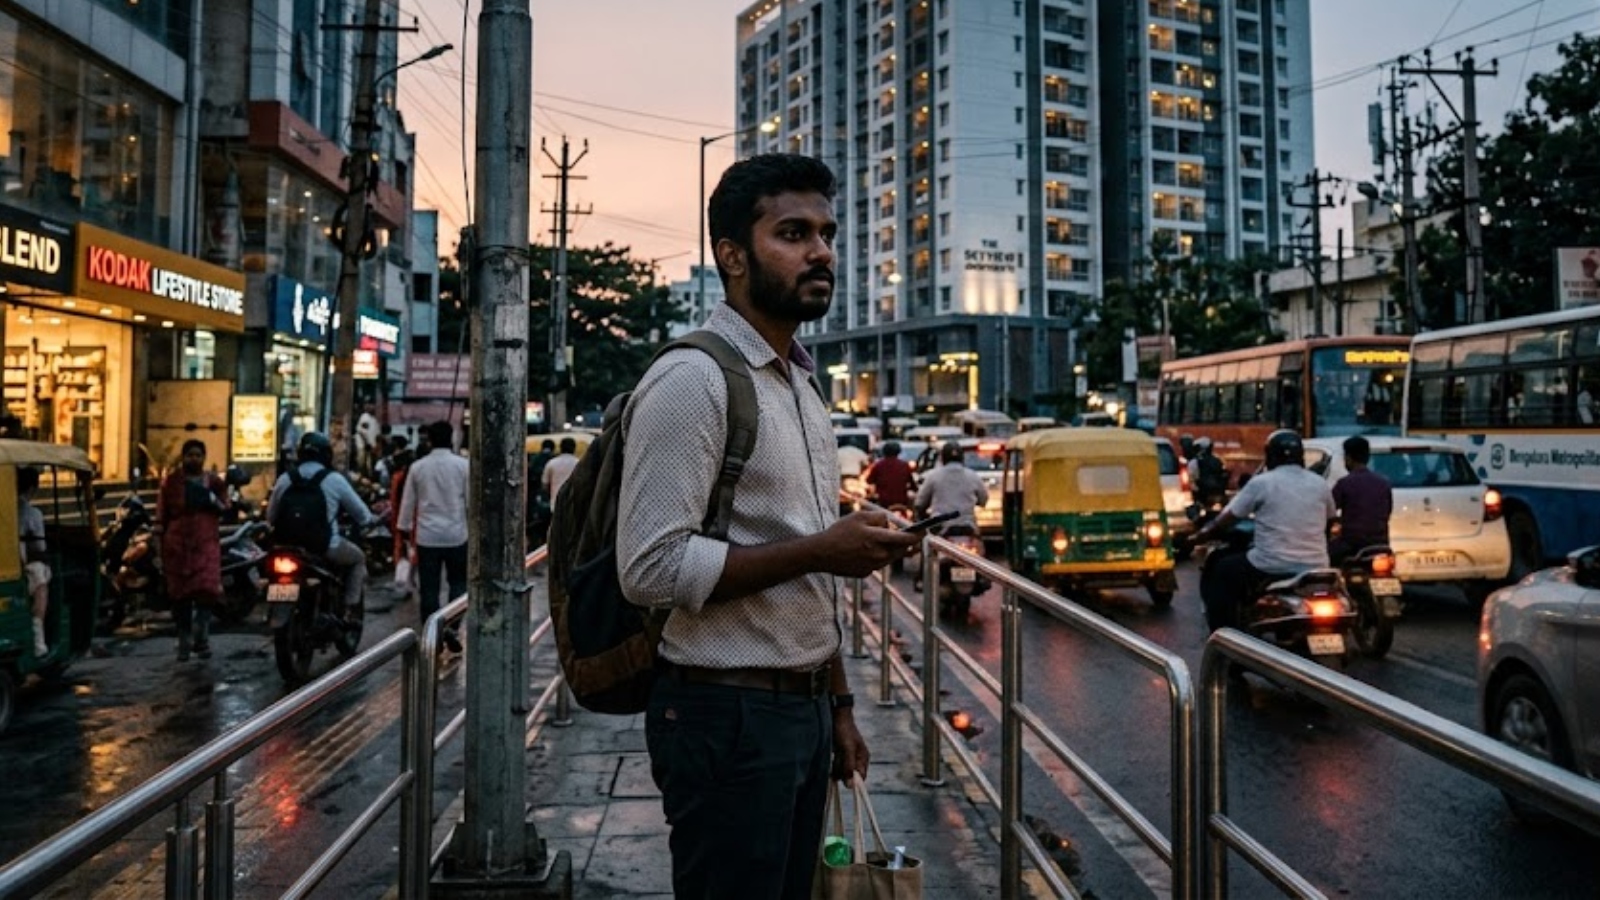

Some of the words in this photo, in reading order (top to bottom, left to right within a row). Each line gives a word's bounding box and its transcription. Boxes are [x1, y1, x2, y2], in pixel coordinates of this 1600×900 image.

[0, 226, 60, 274] LEND
[89, 245, 151, 292] KODAK
[152, 267, 211, 307] LIFESTYLE
